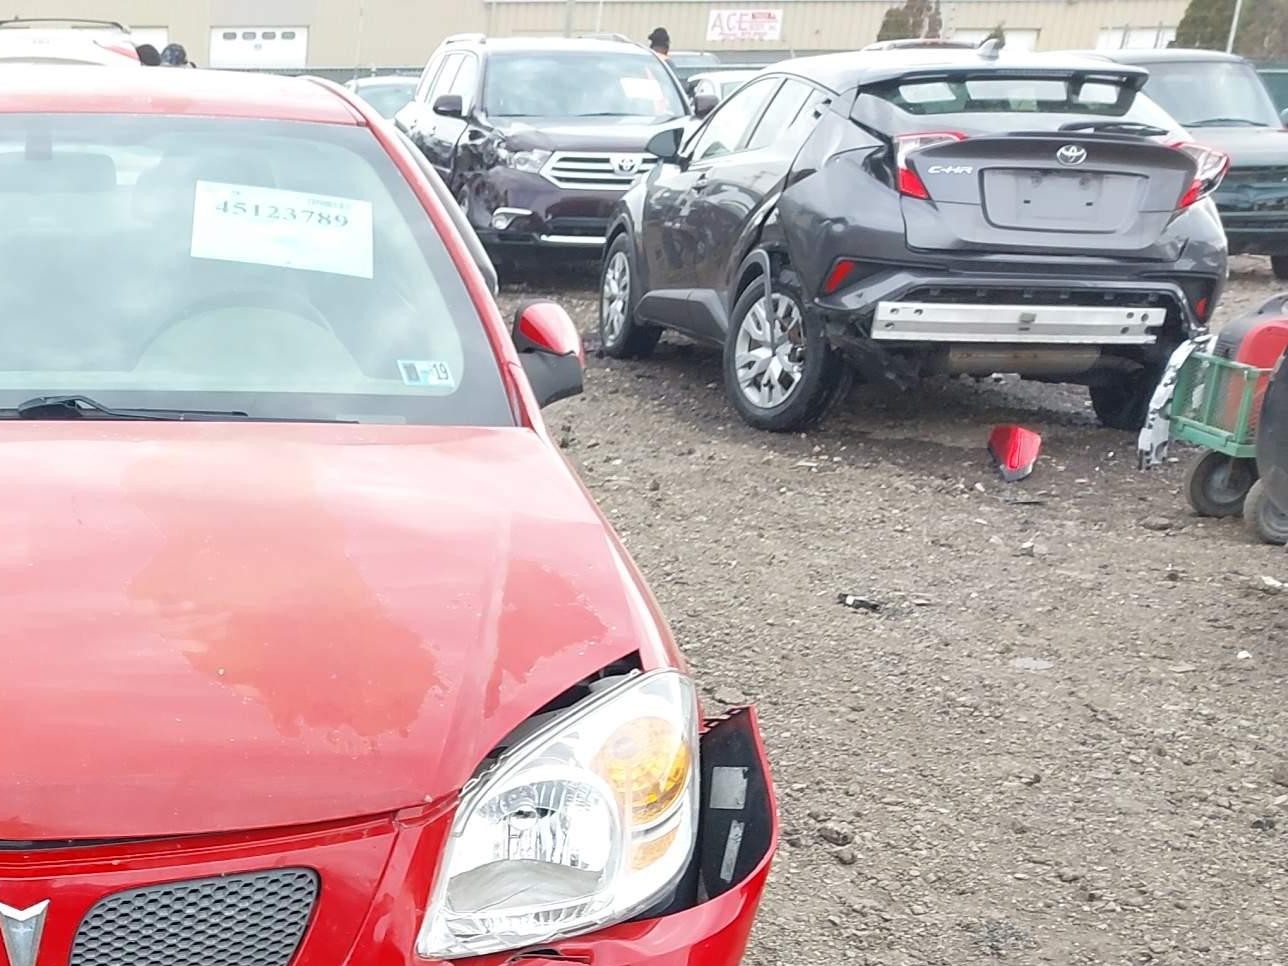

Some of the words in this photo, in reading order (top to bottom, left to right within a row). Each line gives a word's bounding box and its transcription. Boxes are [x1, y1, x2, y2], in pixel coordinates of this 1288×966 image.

[711, 13, 749, 32] ACE
[928, 166, 973, 175] C-HR
[216, 200, 349, 228] 45123789
